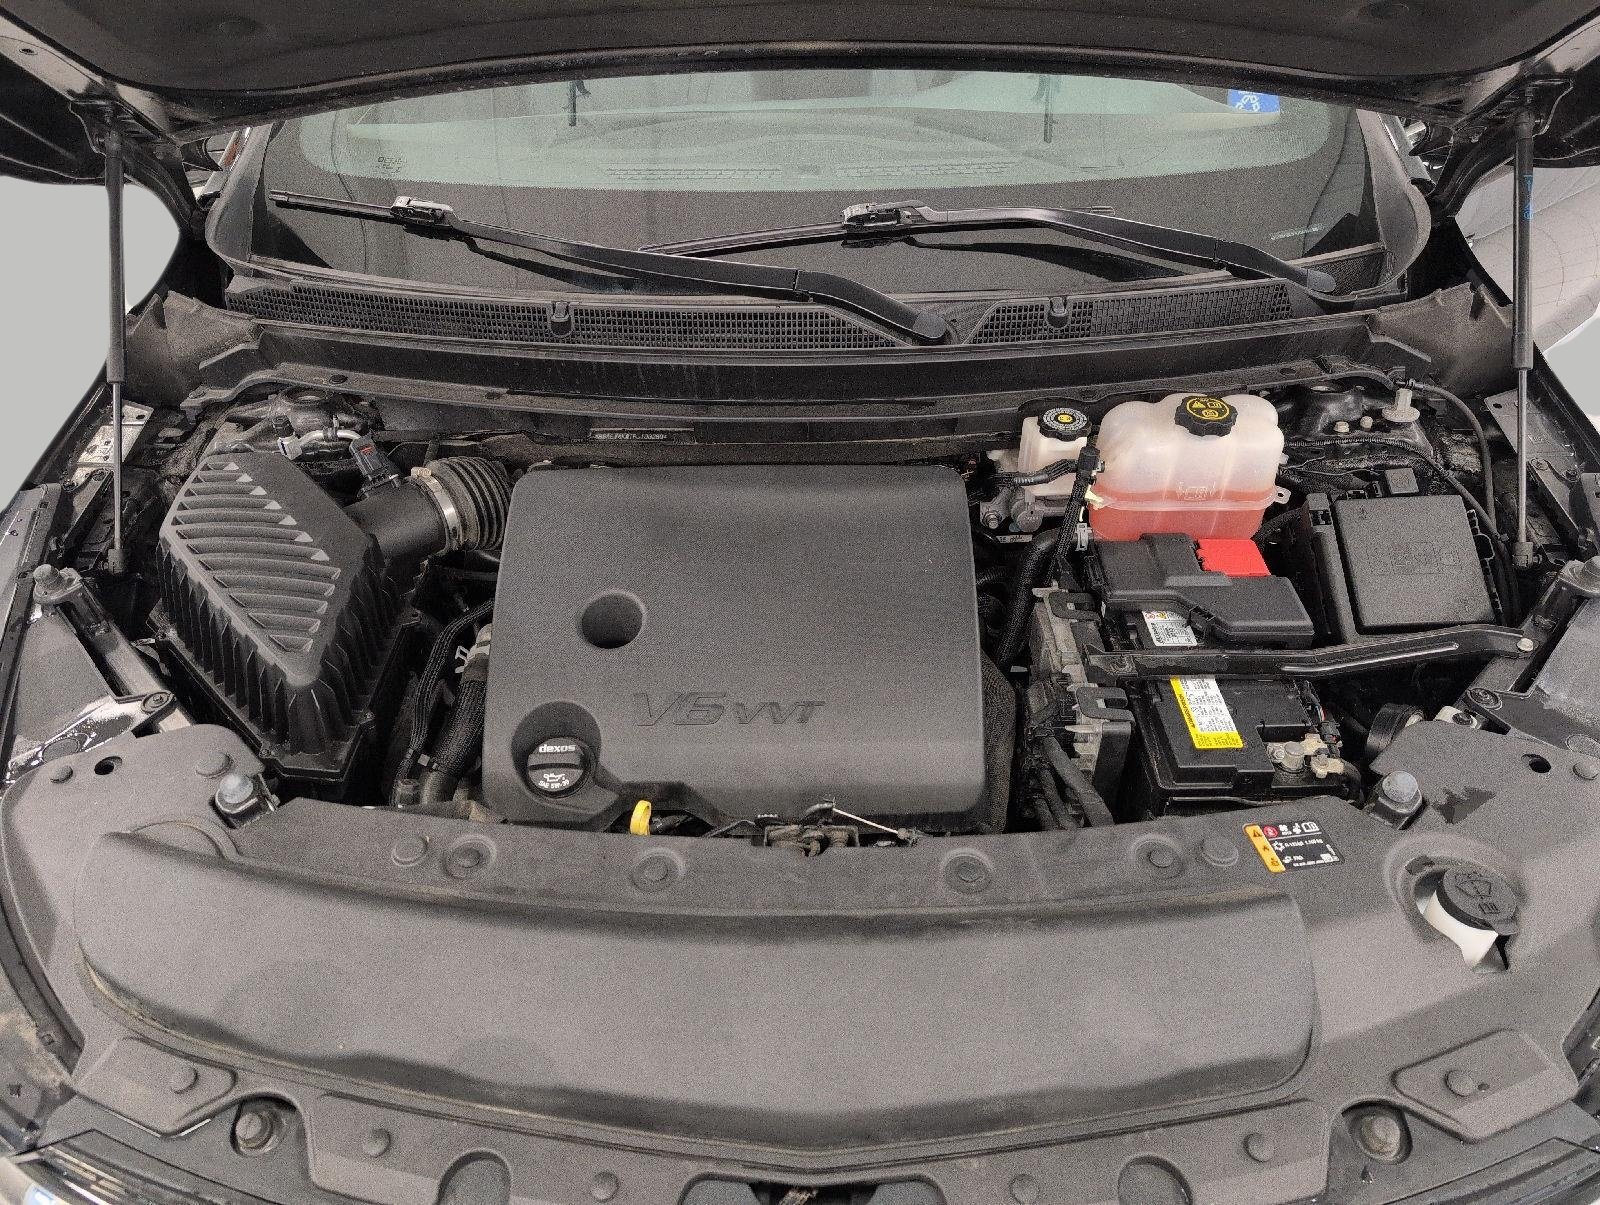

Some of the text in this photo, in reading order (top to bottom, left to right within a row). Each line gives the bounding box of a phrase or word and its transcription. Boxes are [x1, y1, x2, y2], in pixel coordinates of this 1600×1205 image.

[633, 691, 727, 727] V6
[538, 743, 576, 753] dexos
[538, 779, 570, 789] SAE 5W-30
